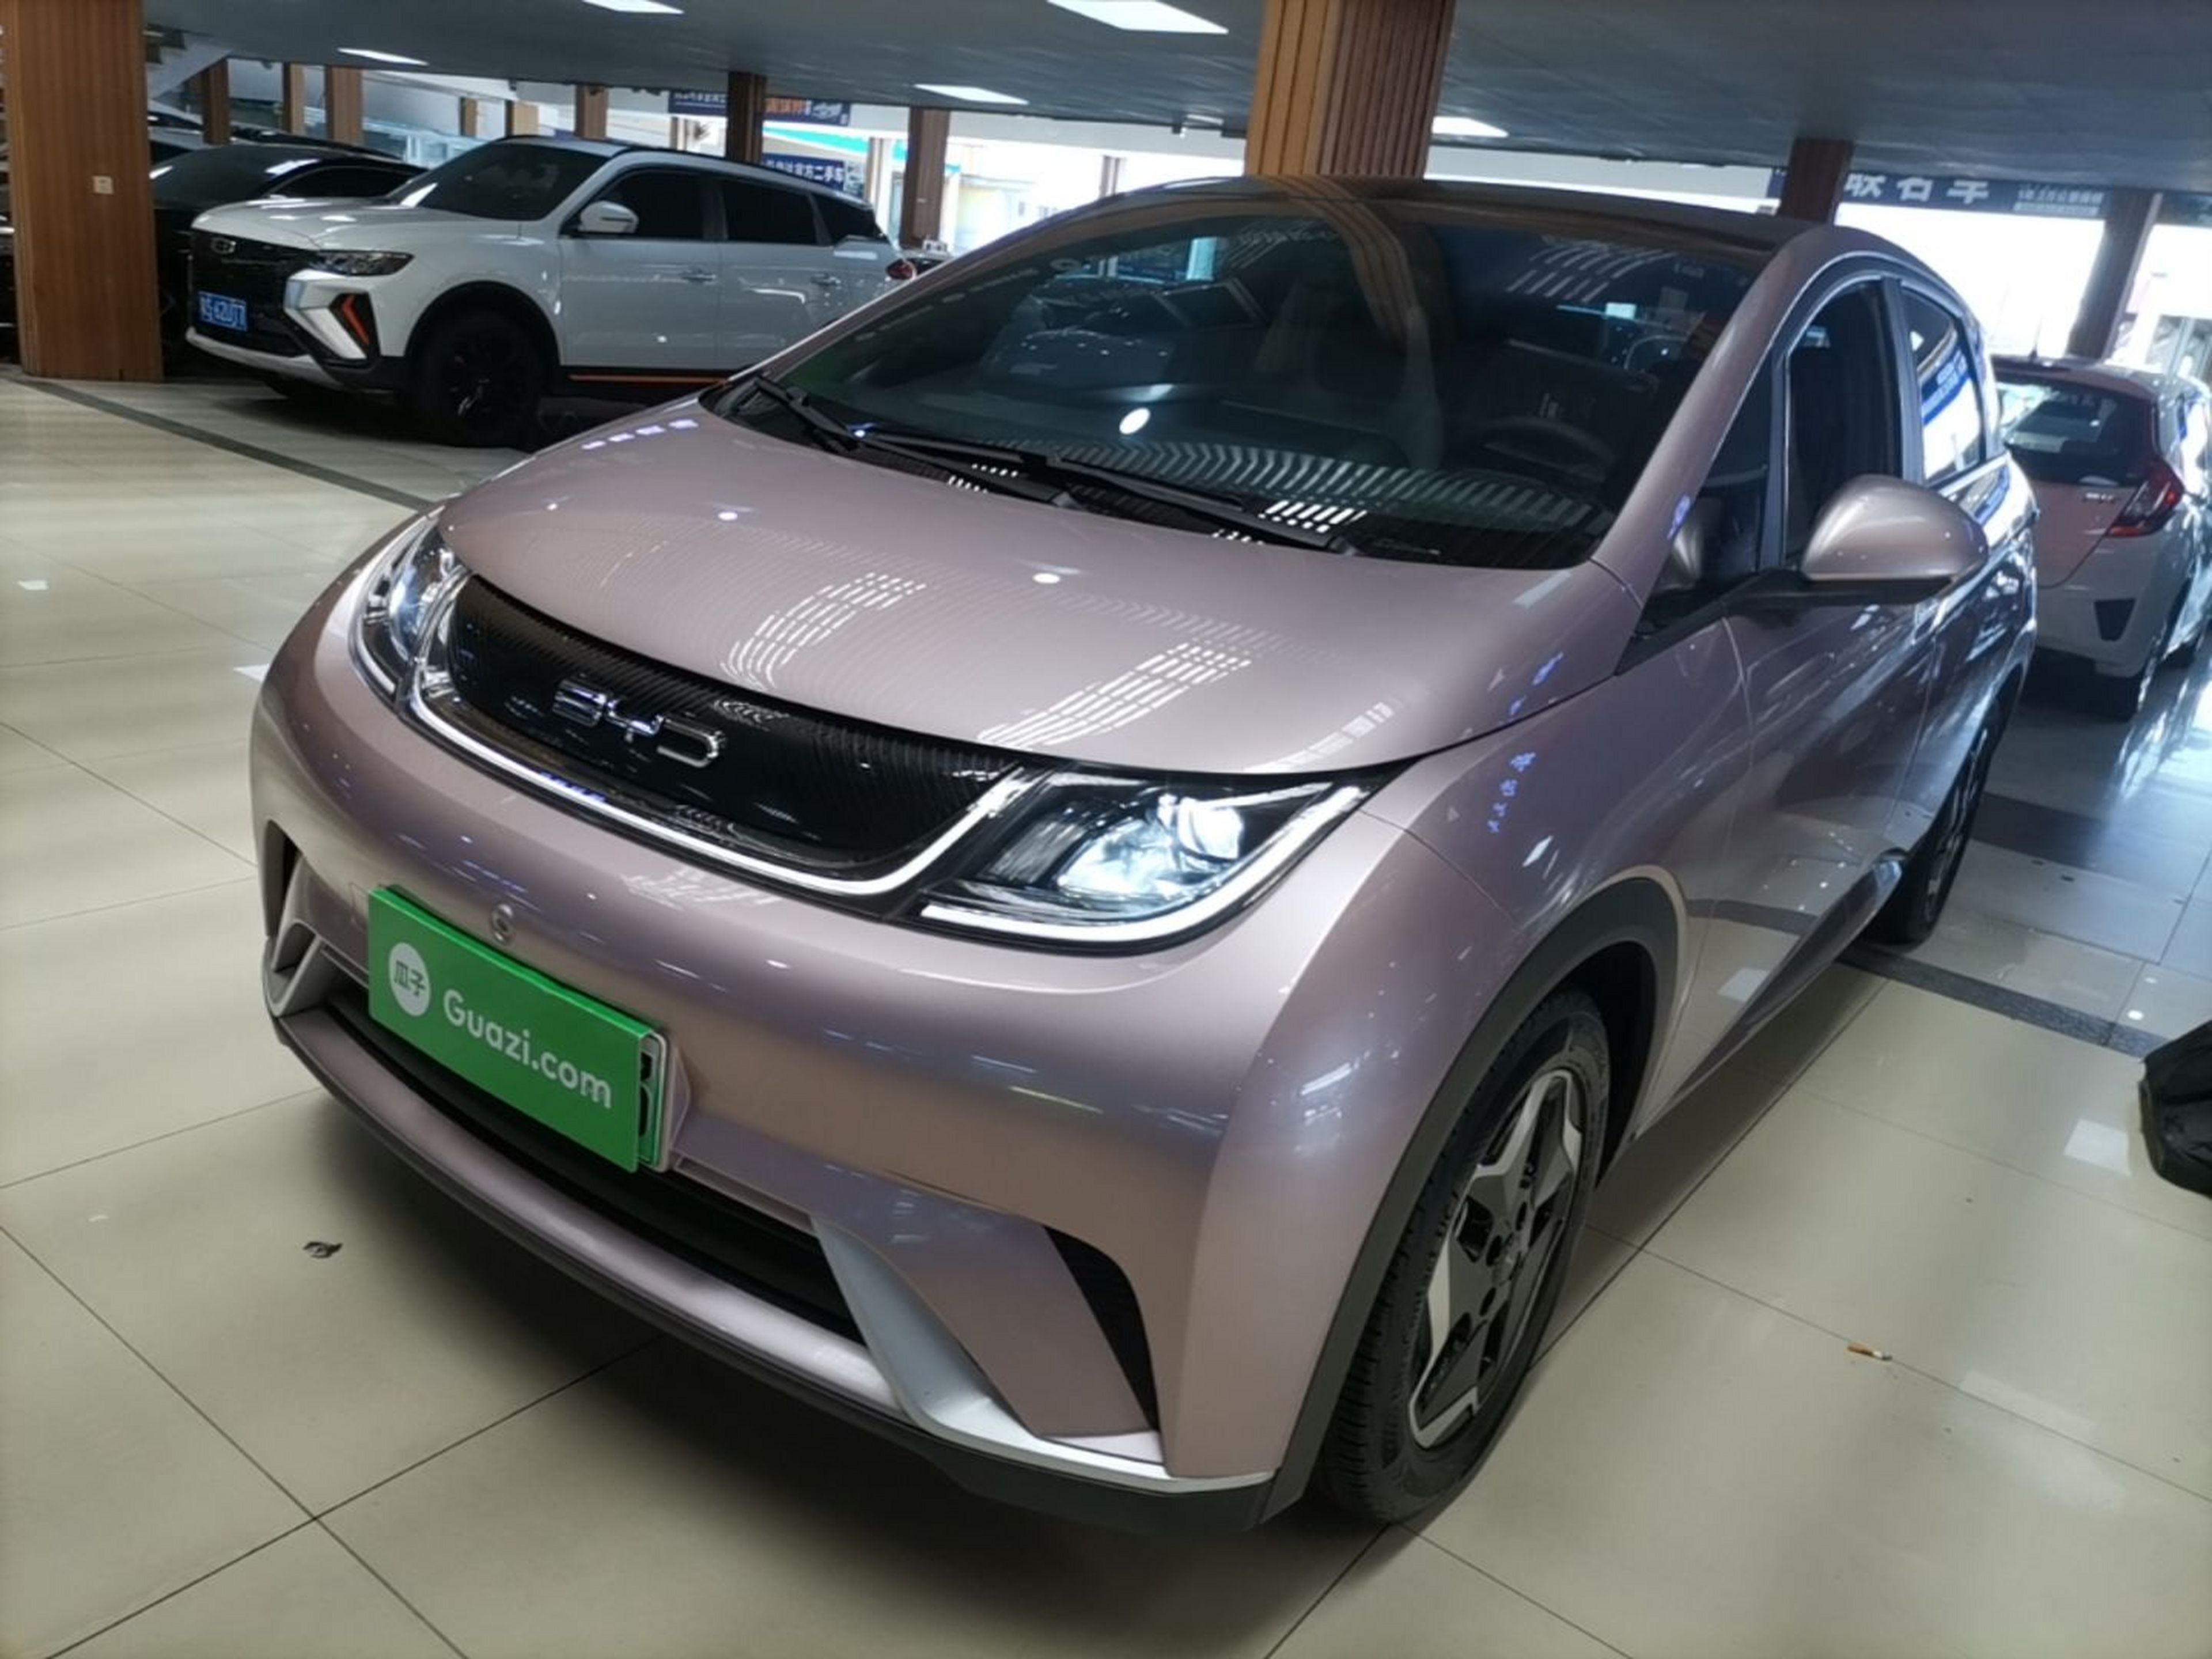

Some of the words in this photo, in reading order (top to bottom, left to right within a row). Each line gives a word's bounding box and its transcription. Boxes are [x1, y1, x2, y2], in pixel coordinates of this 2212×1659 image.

[552, 679, 724, 768] BYD
[393, 959, 427, 997] 瓜子
[443, 988, 612, 1109] Guazi.com
